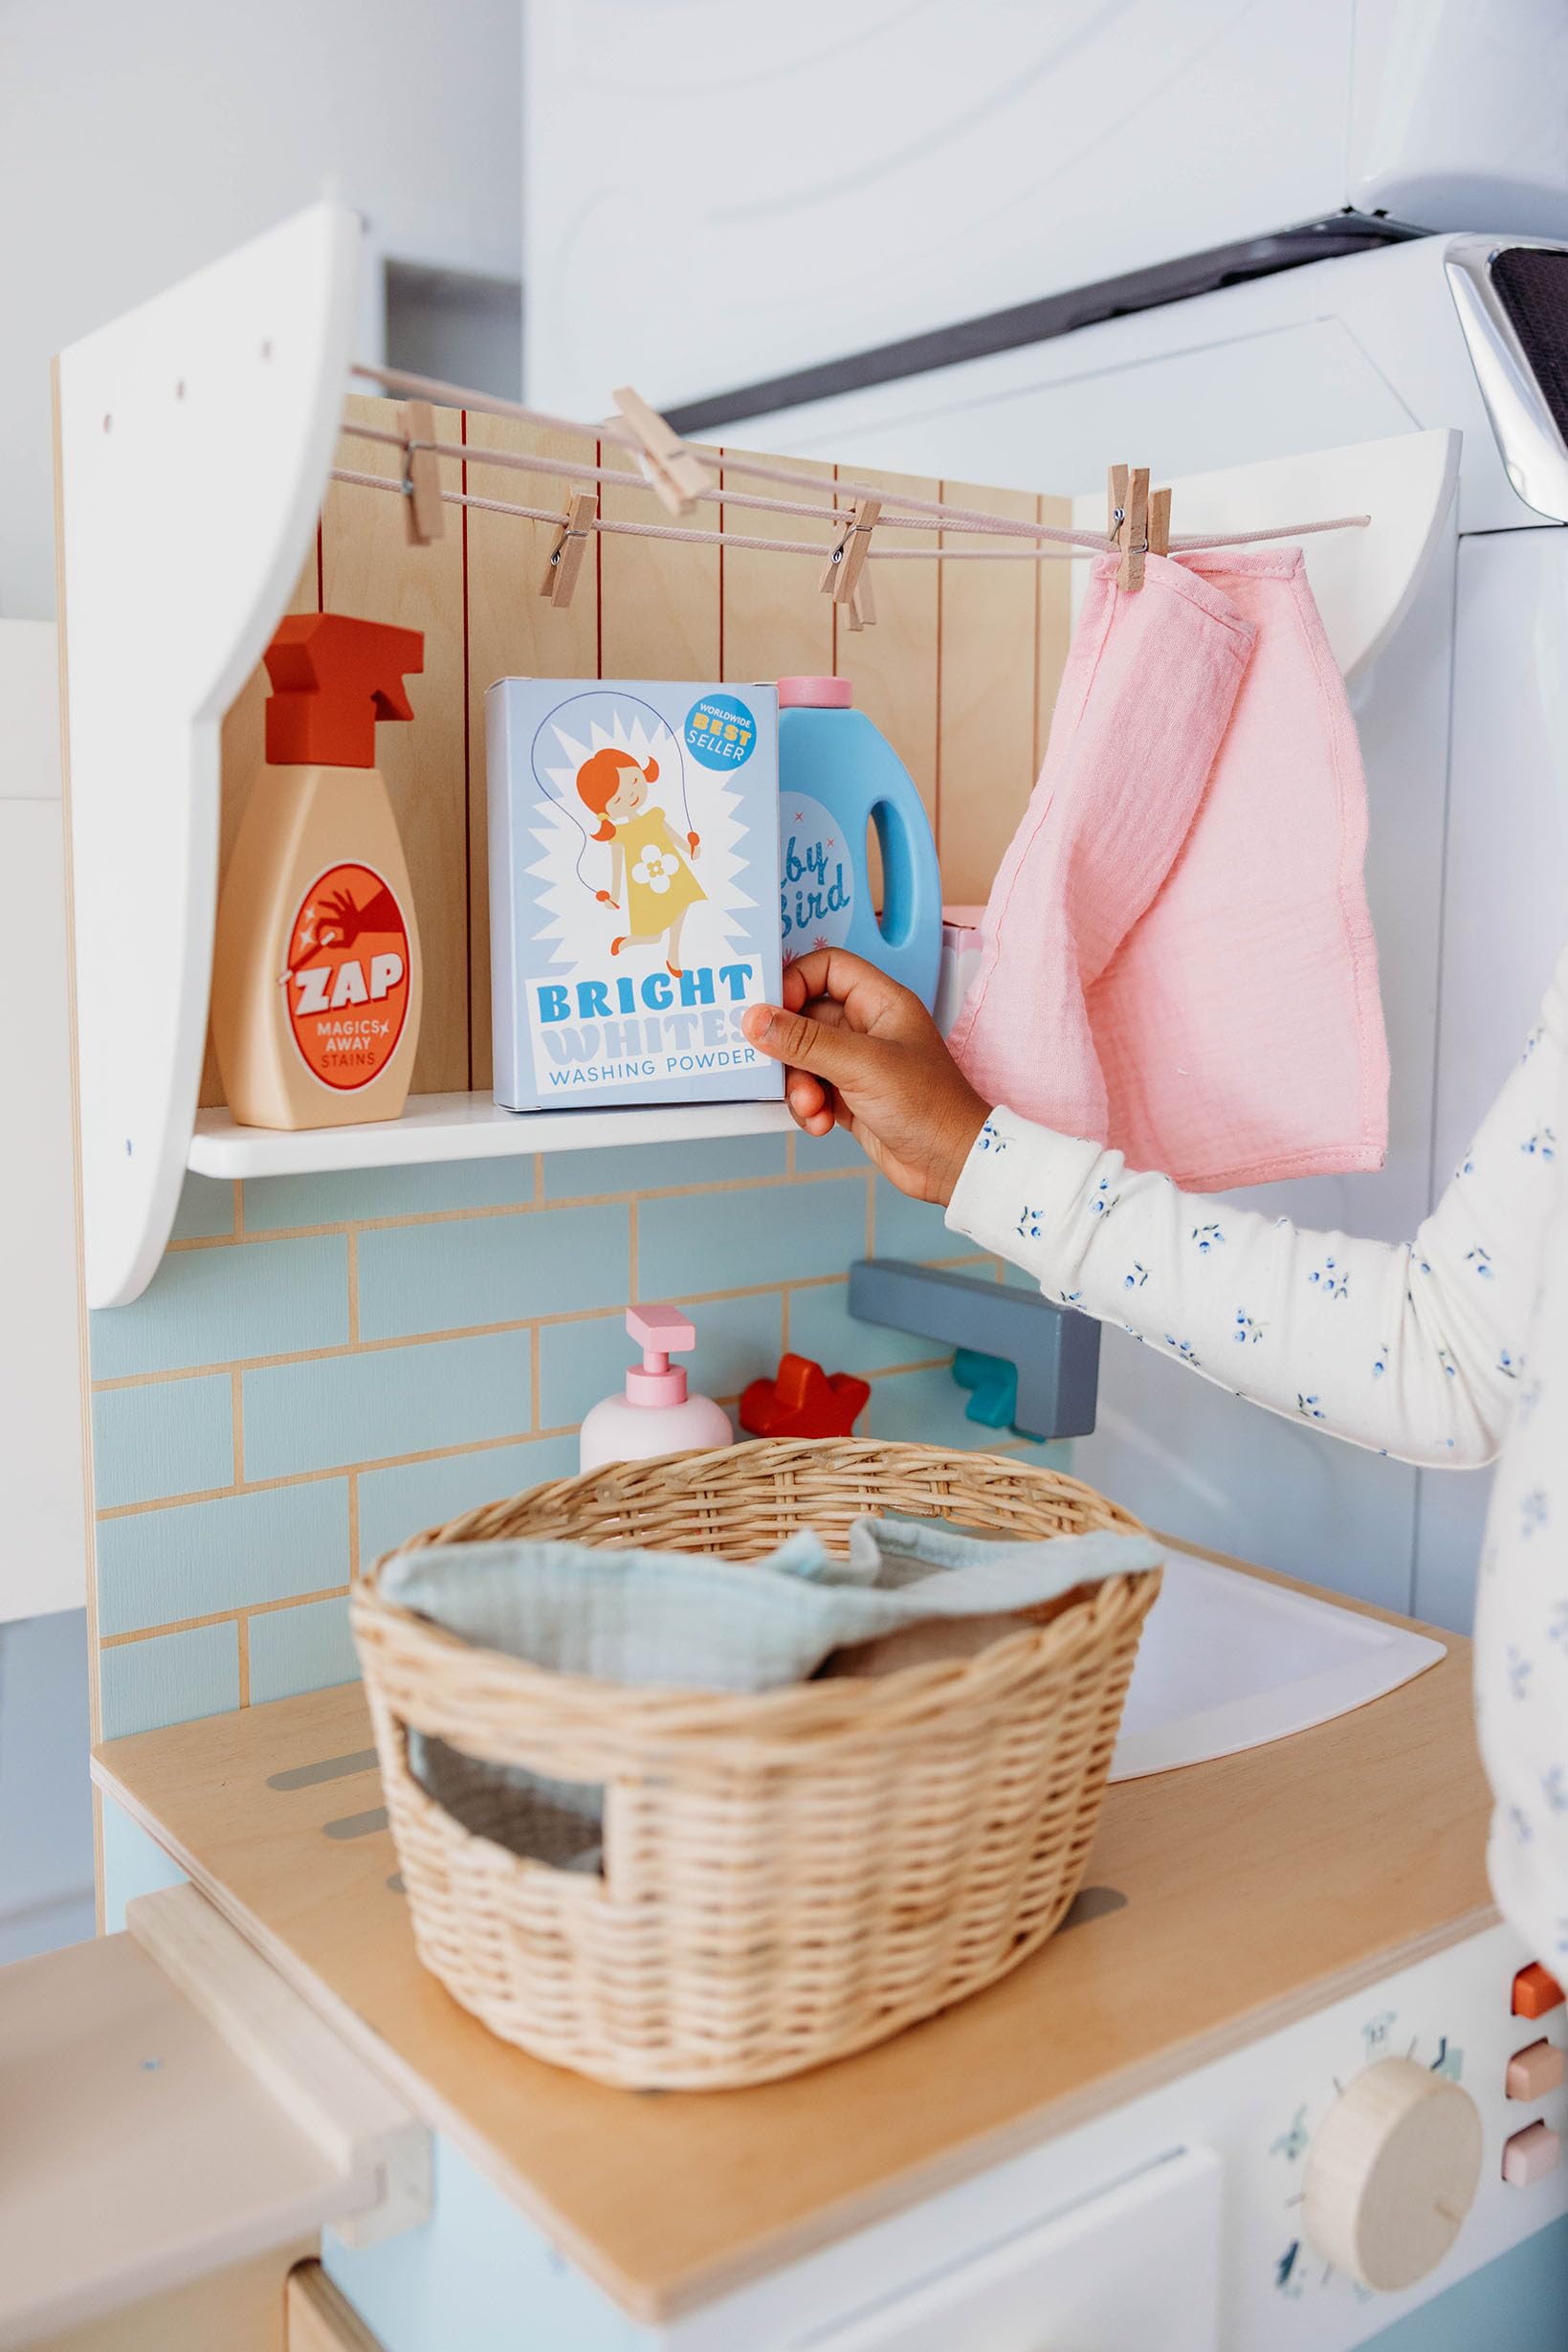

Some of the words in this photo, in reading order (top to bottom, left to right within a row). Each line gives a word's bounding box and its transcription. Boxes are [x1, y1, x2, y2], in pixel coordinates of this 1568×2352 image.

[693, 712, 752, 746] BEST
[700, 703, 751, 728] WORLDWIDE
[687, 730, 744, 761] SELLER
[781, 836, 829, 889] by
[295, 953, 404, 1016] ZAP
[537, 964, 753, 1023] BRIGHT
[317, 1020, 380, 1036] MAGICS
[325, 1036, 372, 1052] AWAY
[321, 1053, 375, 1069] STAINS
[549, 1060, 655, 1086] WASHING
[667, 1048, 757, 1073] POWDER
